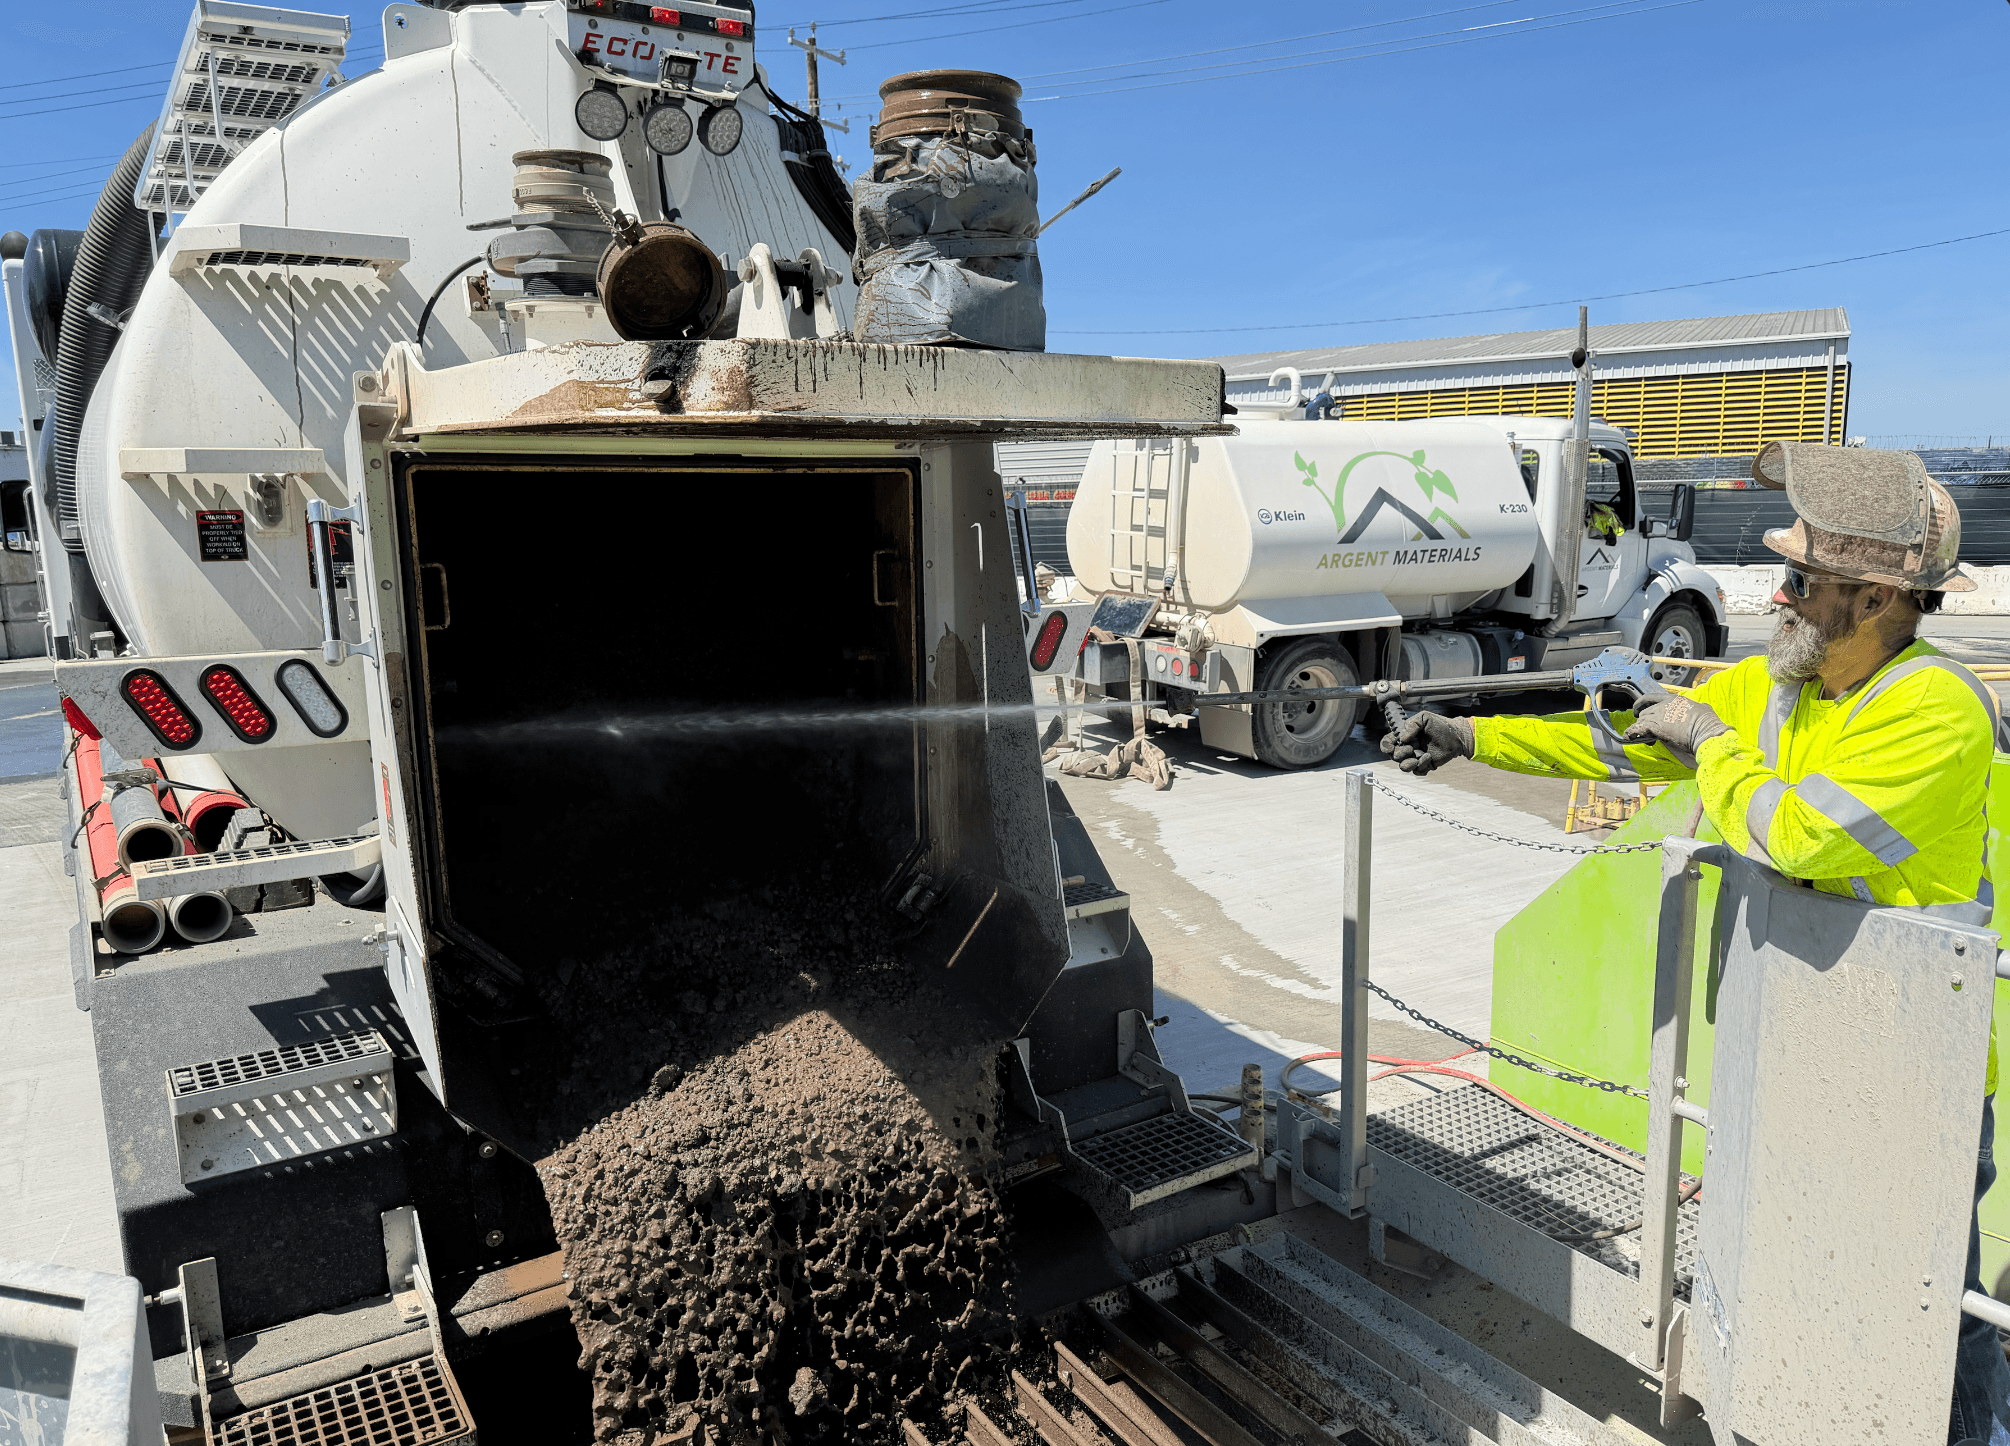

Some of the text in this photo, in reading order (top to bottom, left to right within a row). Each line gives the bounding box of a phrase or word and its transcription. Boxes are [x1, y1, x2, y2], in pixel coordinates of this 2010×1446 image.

[582, 32, 742, 75] ECOTE
[1274, 510, 1306, 522] Klein
[1499, 503, 1528, 514] K-230
[1316, 546, 1482, 570] ARGENT MATERIALS
